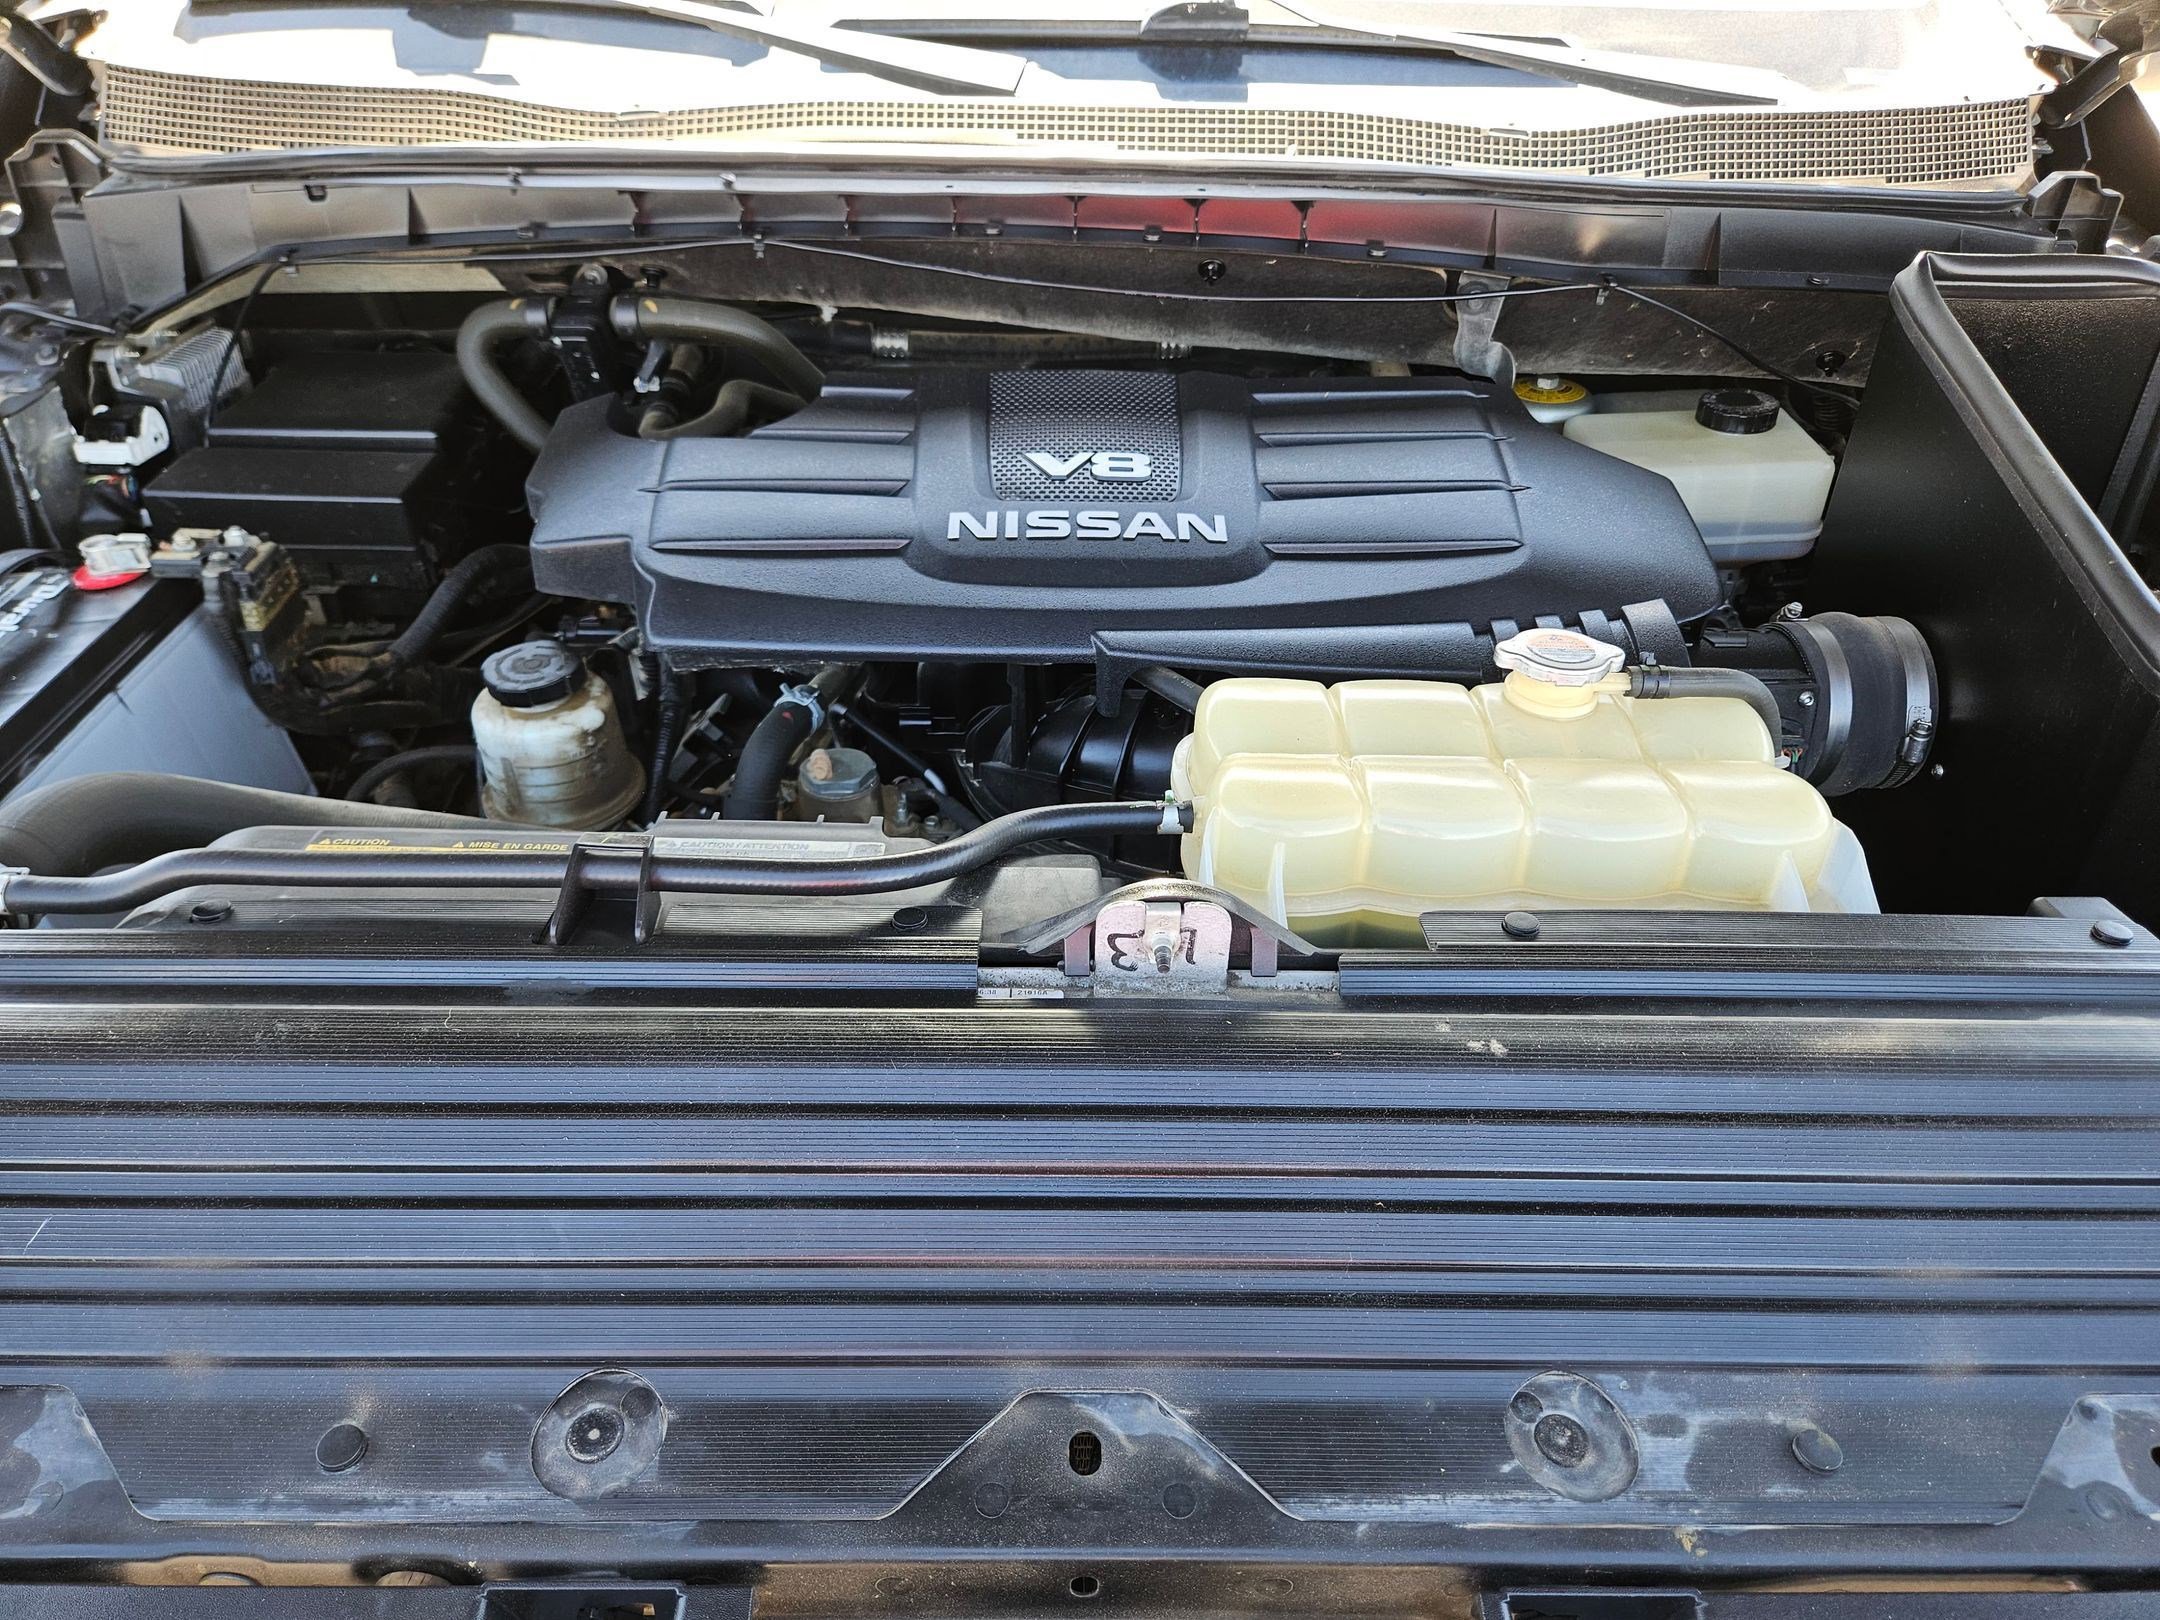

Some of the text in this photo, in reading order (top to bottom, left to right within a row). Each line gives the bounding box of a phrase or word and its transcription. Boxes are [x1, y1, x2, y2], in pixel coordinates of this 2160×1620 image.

[1022, 451, 1152, 482] V8
[946, 509, 1228, 543] NISSAN
[332, 838, 391, 846] CAUTION
[468, 841, 569, 851] MISE EN GARDE
